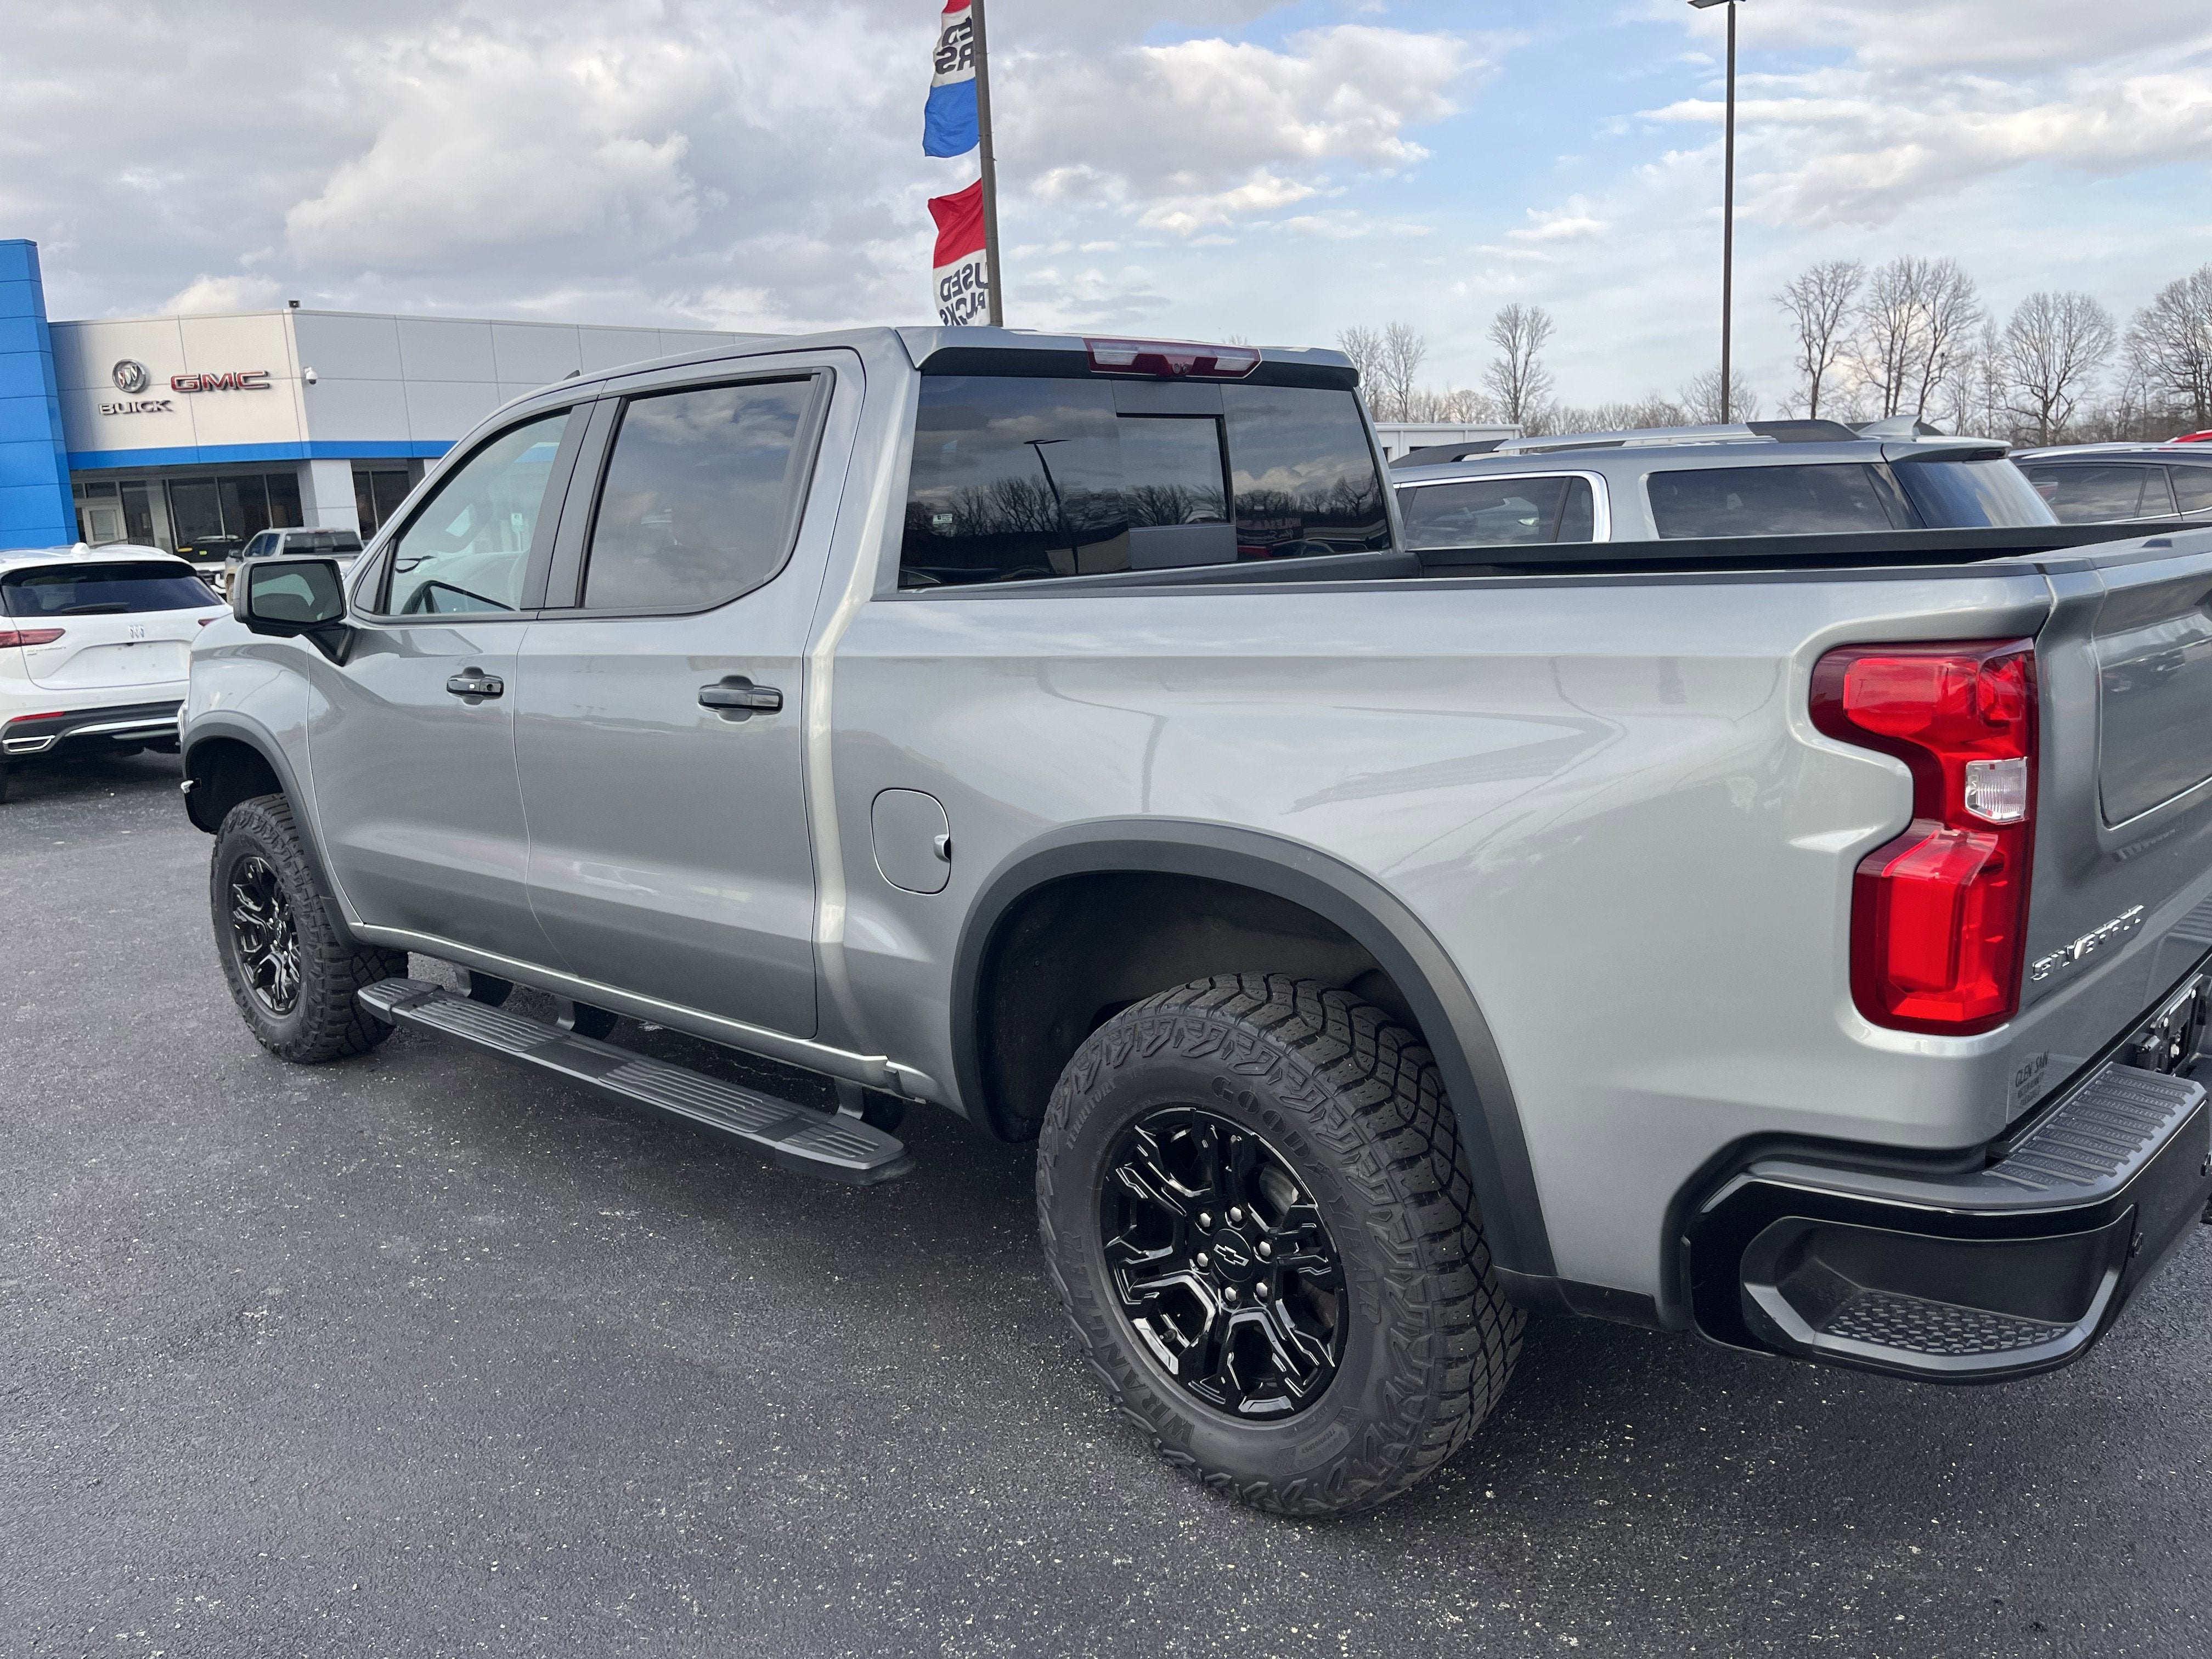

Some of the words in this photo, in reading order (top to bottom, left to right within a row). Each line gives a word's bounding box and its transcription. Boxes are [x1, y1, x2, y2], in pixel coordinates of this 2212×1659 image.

[170, 370, 269, 393] GMC
[98, 399, 173, 415] BUICK
[1061, 1231, 1194, 1448] WRANGLER
